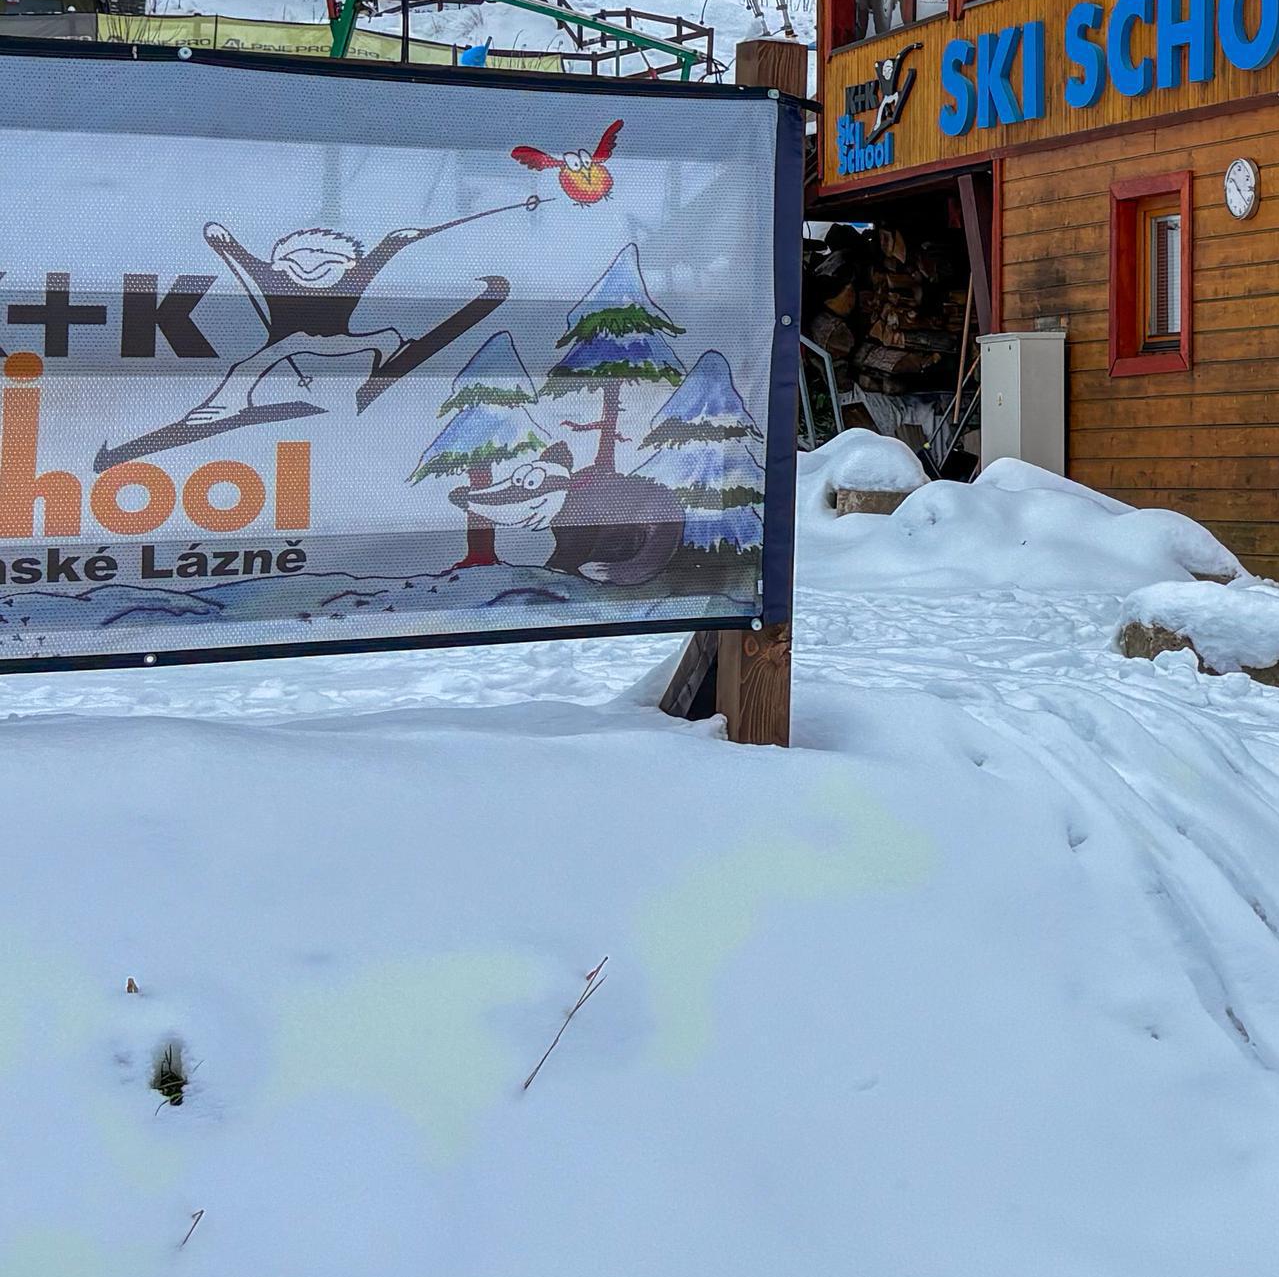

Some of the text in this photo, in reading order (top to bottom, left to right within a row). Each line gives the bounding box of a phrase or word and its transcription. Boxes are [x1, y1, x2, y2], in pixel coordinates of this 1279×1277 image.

[845, 80, 880, 115] K+K
[939, 20, 1045, 136] SKI
[836, 114, 865, 147] Ski
[837, 132, 894, 175] School
[0, 272, 220, 358] +K
[0, 539, 307, 584] ské Lázně
